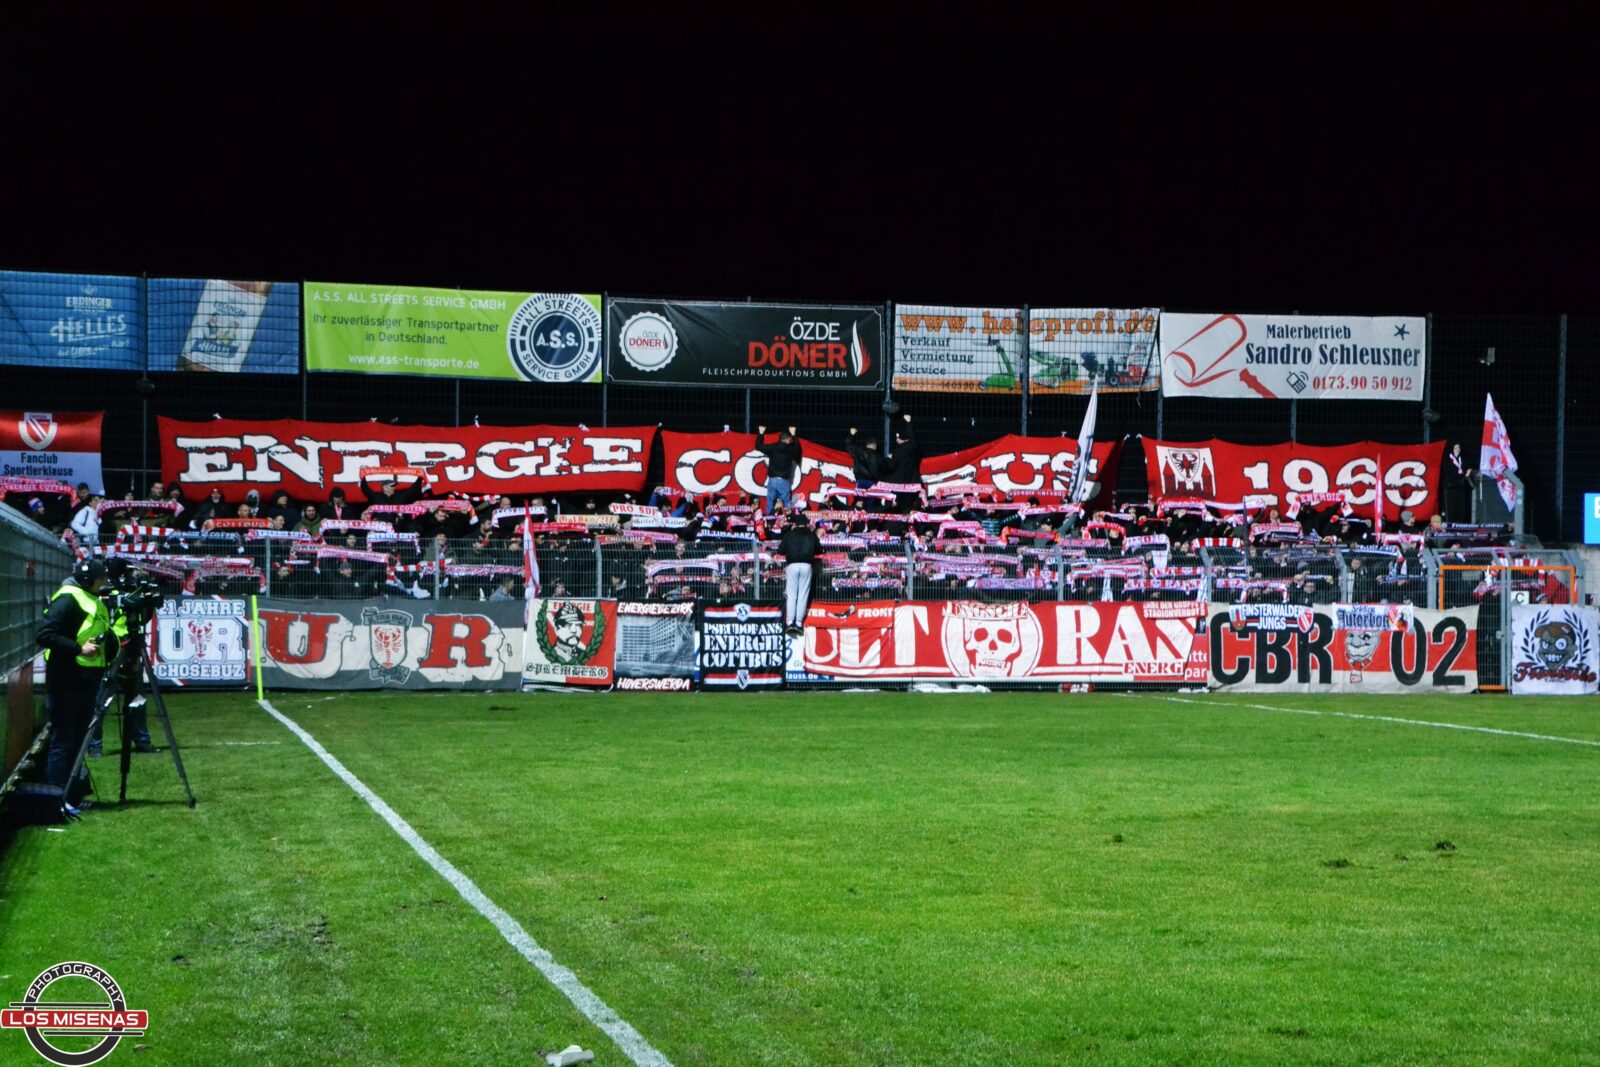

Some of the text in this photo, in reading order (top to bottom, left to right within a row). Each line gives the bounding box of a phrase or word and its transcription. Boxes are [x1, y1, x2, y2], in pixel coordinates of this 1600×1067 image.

[313, 291, 506, 310] A.S.S. ALL STREETS SERVICE GMBH
[524, 300, 591, 327] ALL STREETS
[50, 314, 127, 343] HELLES
[313, 314, 499, 334] Ihr zuverlässiger Transportpartner
[790, 317, 840, 341] ÖZDE
[900, 311, 1157, 342] www.heeprofi.de
[365, 332, 448, 345] in Deutschland.
[536, 330, 579, 349] A.S.S.
[1266, 324, 1352, 340] Malerbetrieb
[901, 335, 951, 347] Verkauf
[748, 336, 848, 369] DÖNER
[901, 350, 975, 365] Vermietung
[1245, 343, 1421, 367] Sandro Schleusner
[349, 354, 480, 370] www.ass-transporte.de
[523, 353, 591, 380] SERVICE GMBH
[901, 364, 947, 375] Service
[703, 368, 848, 378] FLEISCHPRODUKTIONS GMBH
[1312, 375, 1413, 391] 0173.90 50 912
[20, 453, 58, 464] Fanclub
[4, 464, 74, 477] Sportlerklause
[175, 435, 643, 488] ENERGIE
[1243, 458, 1430, 507] 1966
[1300, 491, 1342, 502] ENERGIE
[179, 601, 243, 615] JAHRE
[617, 602, 694, 615] ENERGIEBEZIRK
[1241, 604, 1304, 617] FINSTERWALDER
[703, 622, 782, 635] PSEUDOFANS
[1257, 617, 1287, 630] JUNGS
[703, 635, 783, 651] ENERGIE
[703, 652, 783, 667] COTTBUS
[617, 678, 690, 691] HOYERSWERDA
